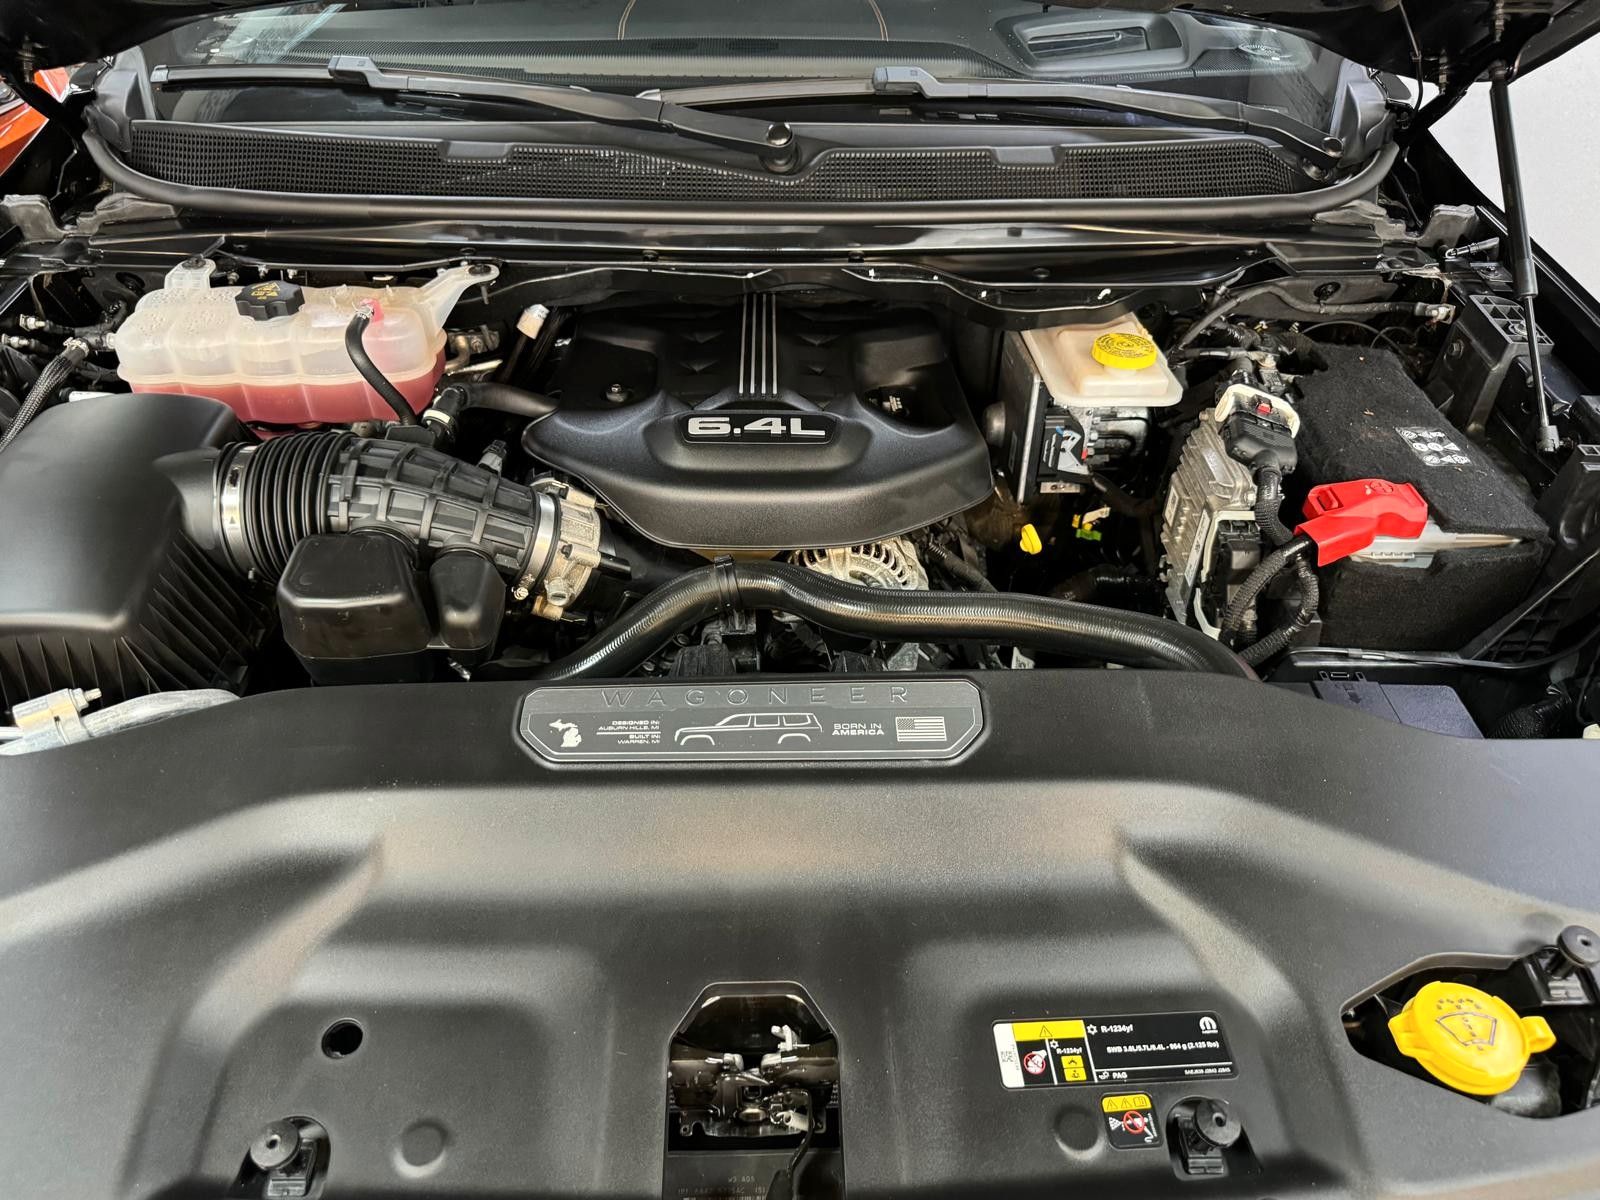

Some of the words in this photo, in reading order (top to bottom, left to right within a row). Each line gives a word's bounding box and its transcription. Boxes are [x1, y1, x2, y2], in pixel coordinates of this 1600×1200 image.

[688, 416, 826, 438] 6.4L
[601, 687, 908, 706] WAGONEER
[1100, 1023, 1134, 1034] R-1234yf
[1112, 1071, 1128, 1079] PAG
